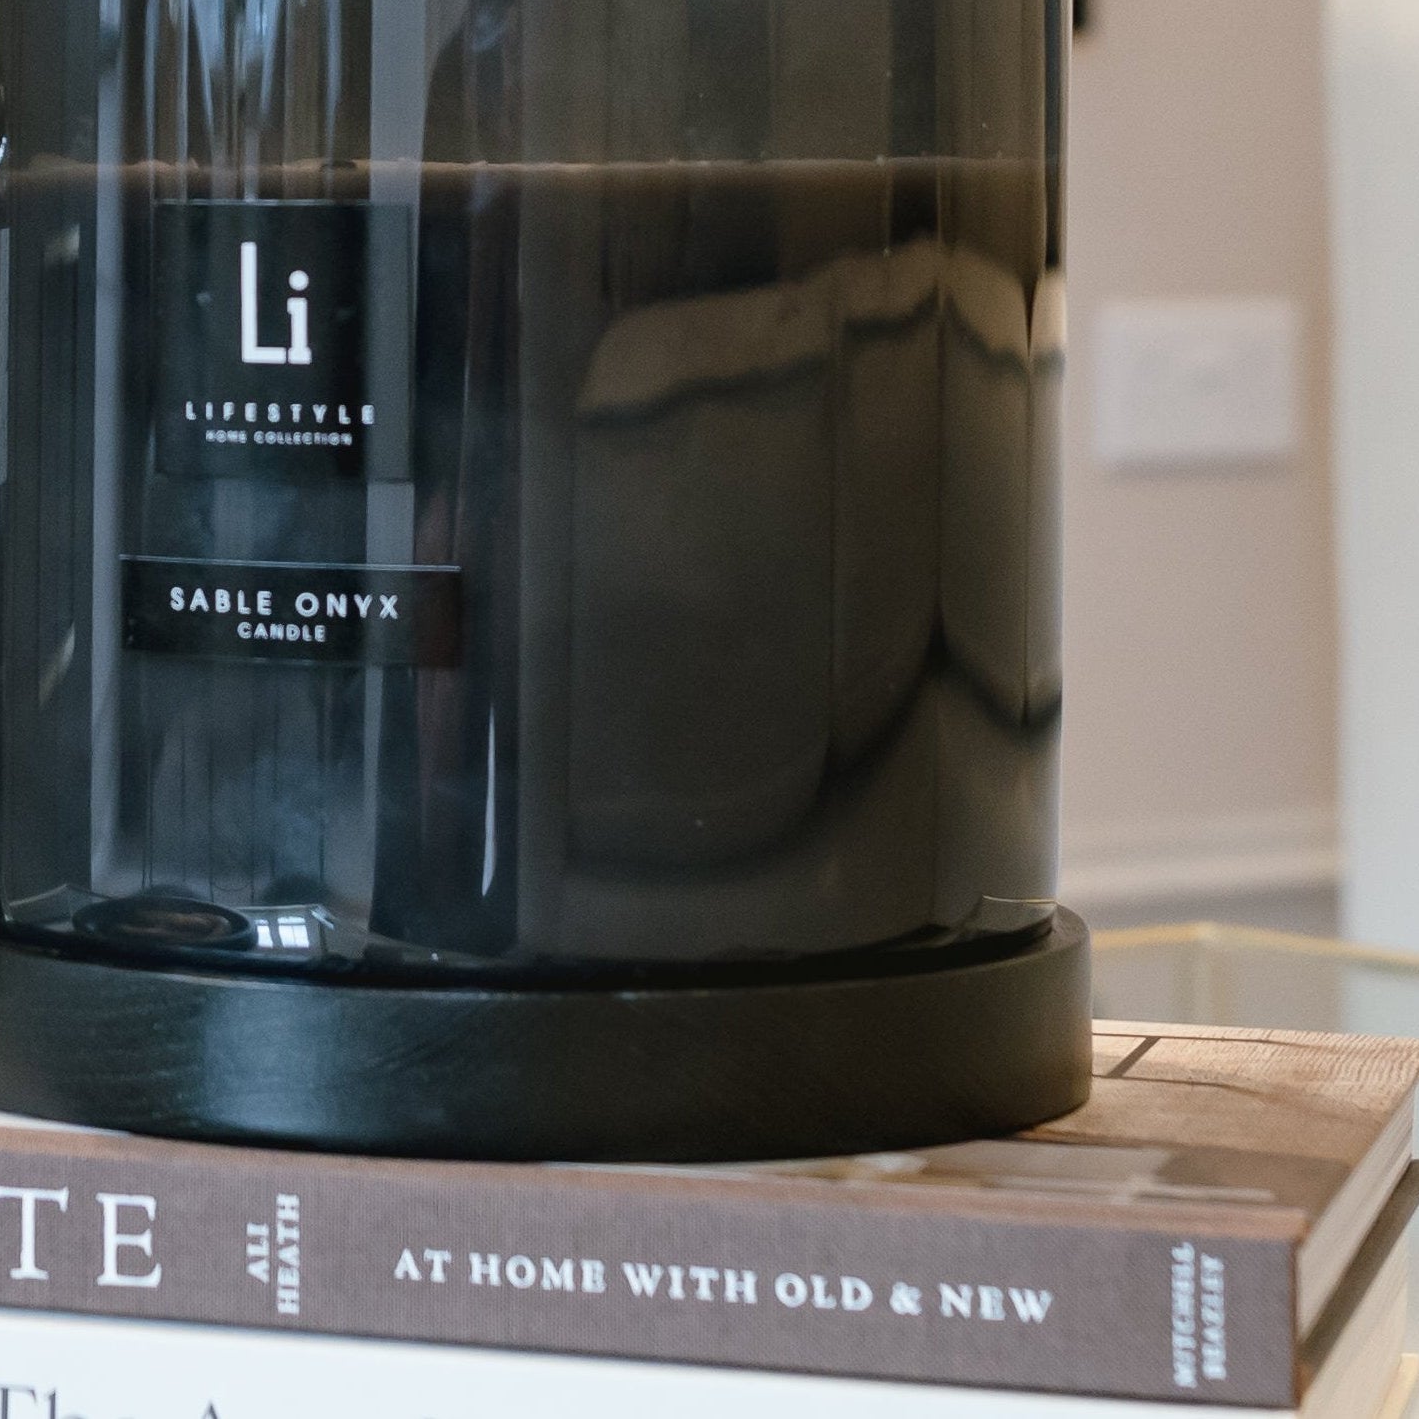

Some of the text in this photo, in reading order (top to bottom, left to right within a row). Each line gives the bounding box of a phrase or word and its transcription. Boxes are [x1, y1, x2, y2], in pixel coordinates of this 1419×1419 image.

[239, 241, 313, 366] Li
[185, 400, 376, 425] LIFESTYLE
[205, 429, 353, 446] HOME COLLECTION
[169, 586, 400, 620] SABLE ONYX
[237, 622, 326, 643] CANDLE
[246, 1222, 270, 1284] ALI
[277, 1193, 301, 1316] HEATH
[394, 1249, 1054, 1326] AT HOME WITH OLD & NEW
